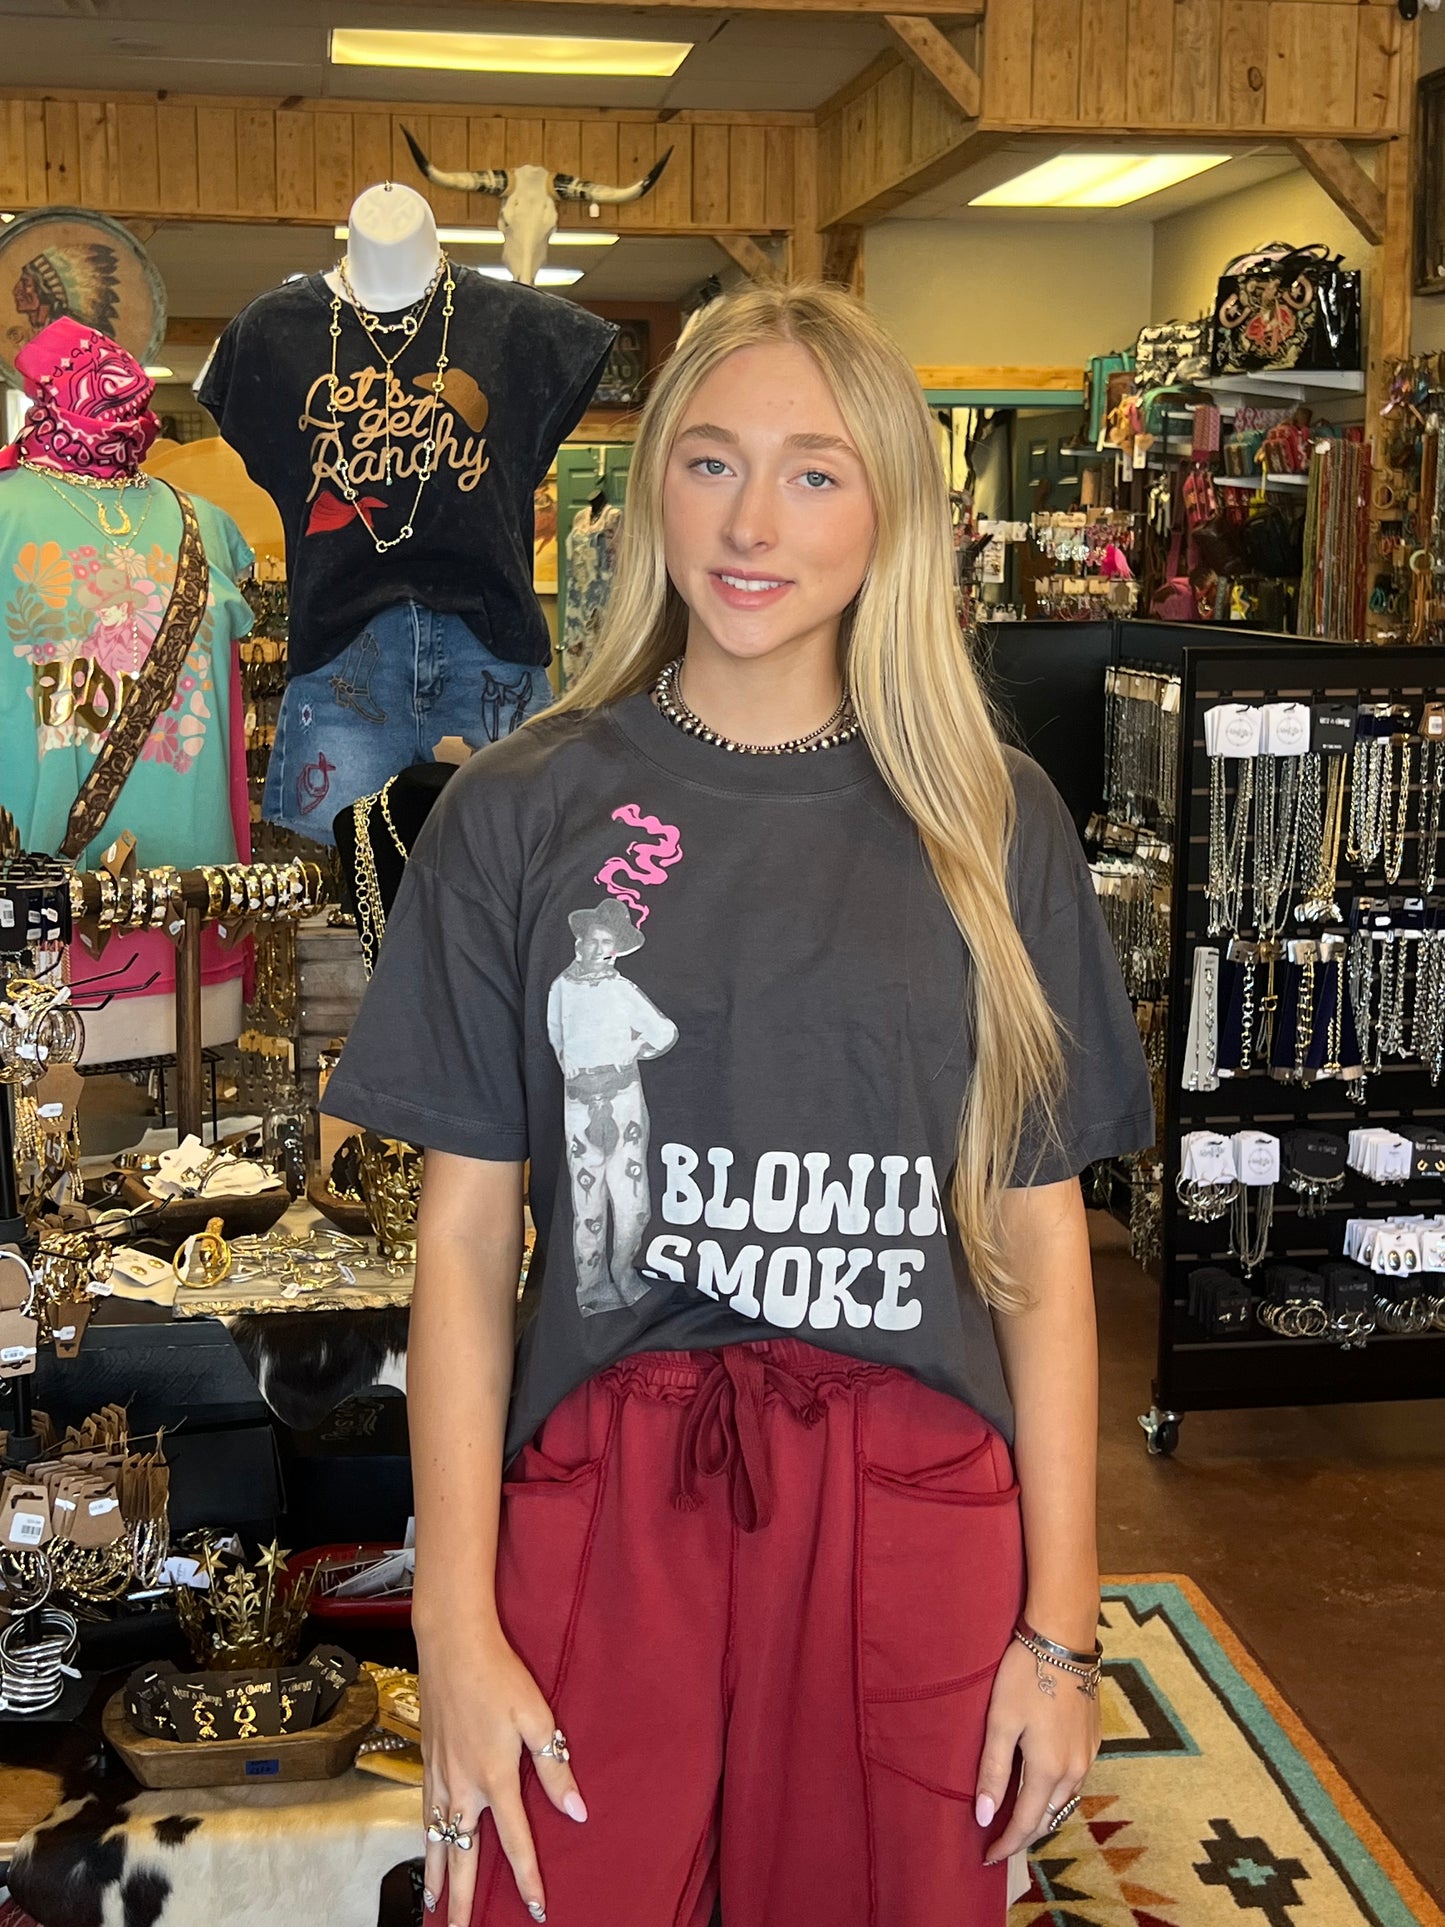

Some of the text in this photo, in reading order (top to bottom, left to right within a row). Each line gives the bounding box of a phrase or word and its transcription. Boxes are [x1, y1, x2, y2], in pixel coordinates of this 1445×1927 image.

[299, 366, 414, 431] Let's
[352, 395, 445, 449] get
[306, 412, 490, 503] Ranchy
[641, 1234, 926, 1331] SMOKE
